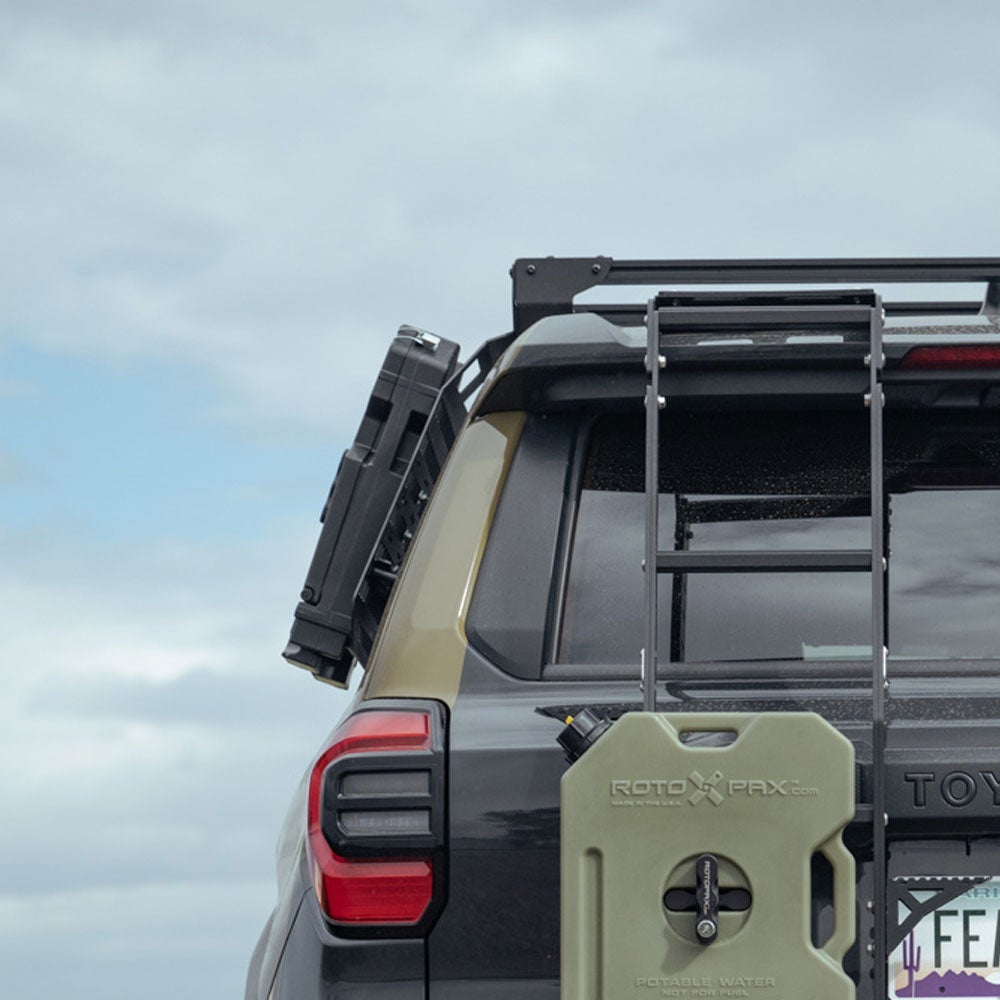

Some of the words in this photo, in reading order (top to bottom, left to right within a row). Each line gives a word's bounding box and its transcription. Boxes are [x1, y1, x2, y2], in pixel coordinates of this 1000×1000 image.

[611, 779, 687, 796] ROTO
[635, 977, 712, 988] POTABLE
[719, 977, 777, 987] WATER
